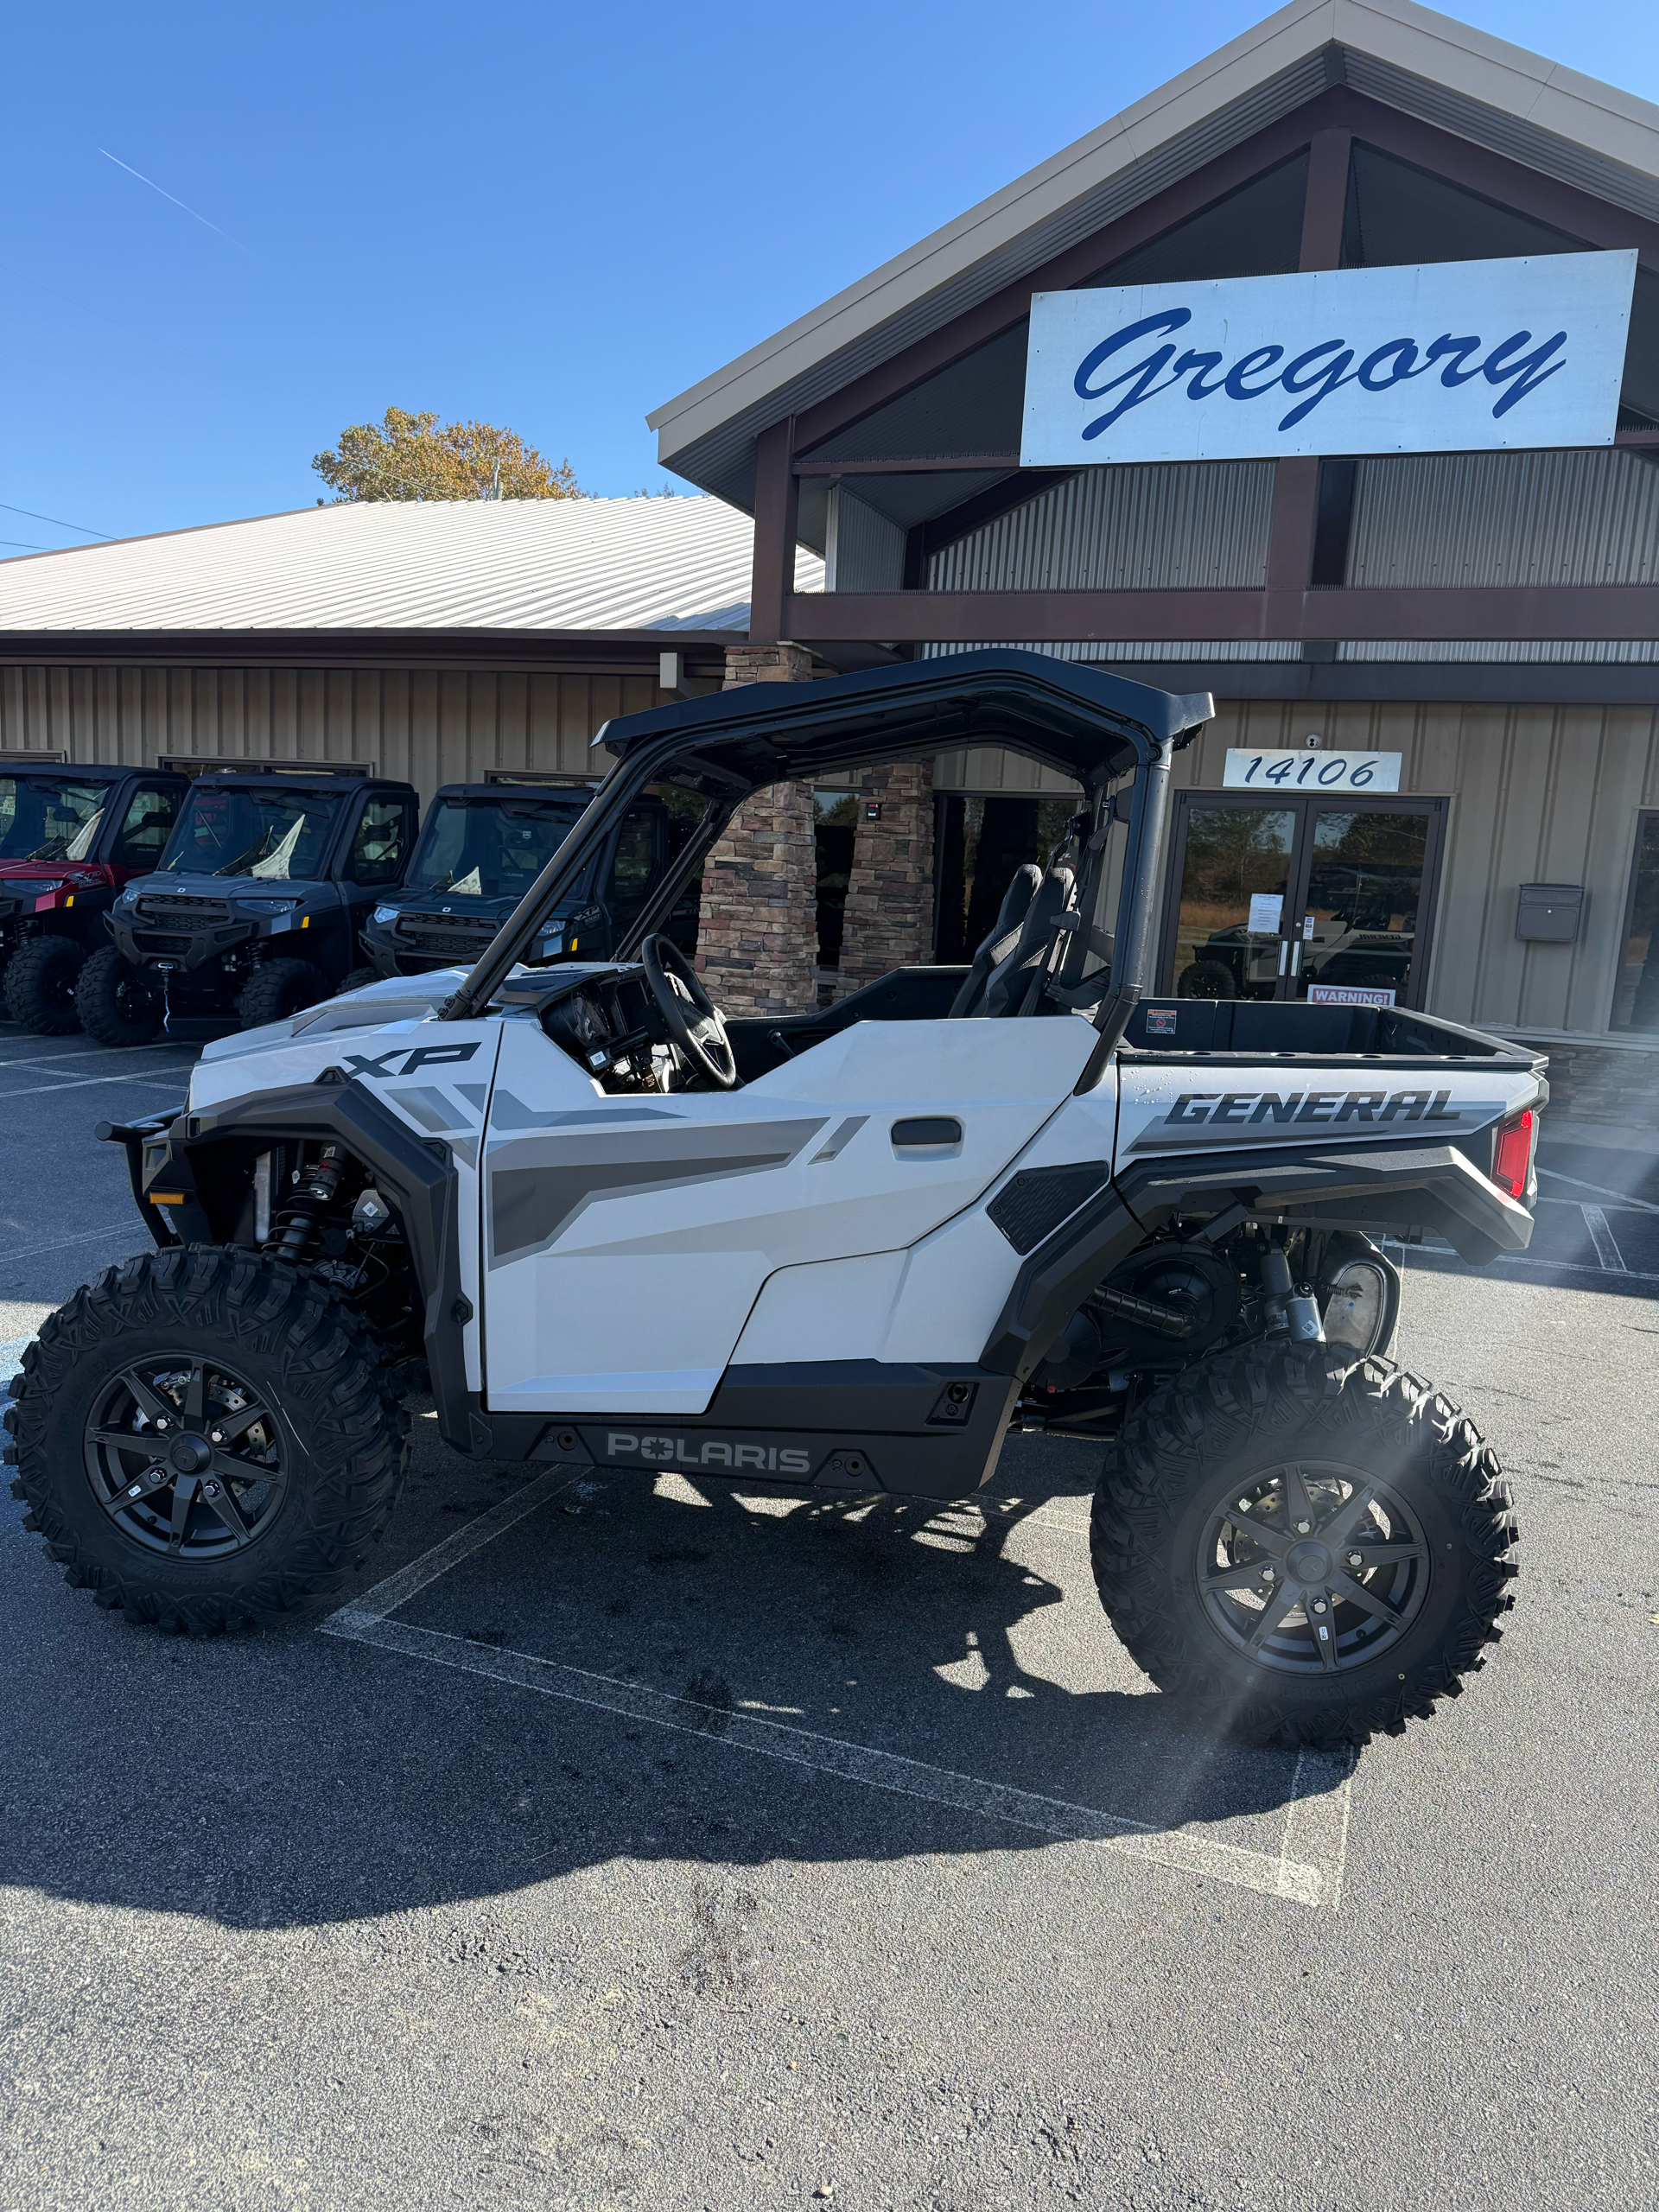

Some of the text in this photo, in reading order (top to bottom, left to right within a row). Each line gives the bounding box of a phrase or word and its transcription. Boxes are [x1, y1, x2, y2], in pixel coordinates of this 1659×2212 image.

[1073, 307, 1567, 442] Gregory
[1244, 756, 1380, 787] 14106
[74, 871, 102, 883] XP
[577, 906, 599, 920] XP
[1315, 989, 1389, 1005] WARNING!
[342, 1041, 483, 1078] XP
[1163, 1090, 1461, 1124] GENERAL
[607, 1433, 810, 1473] POLARIS
